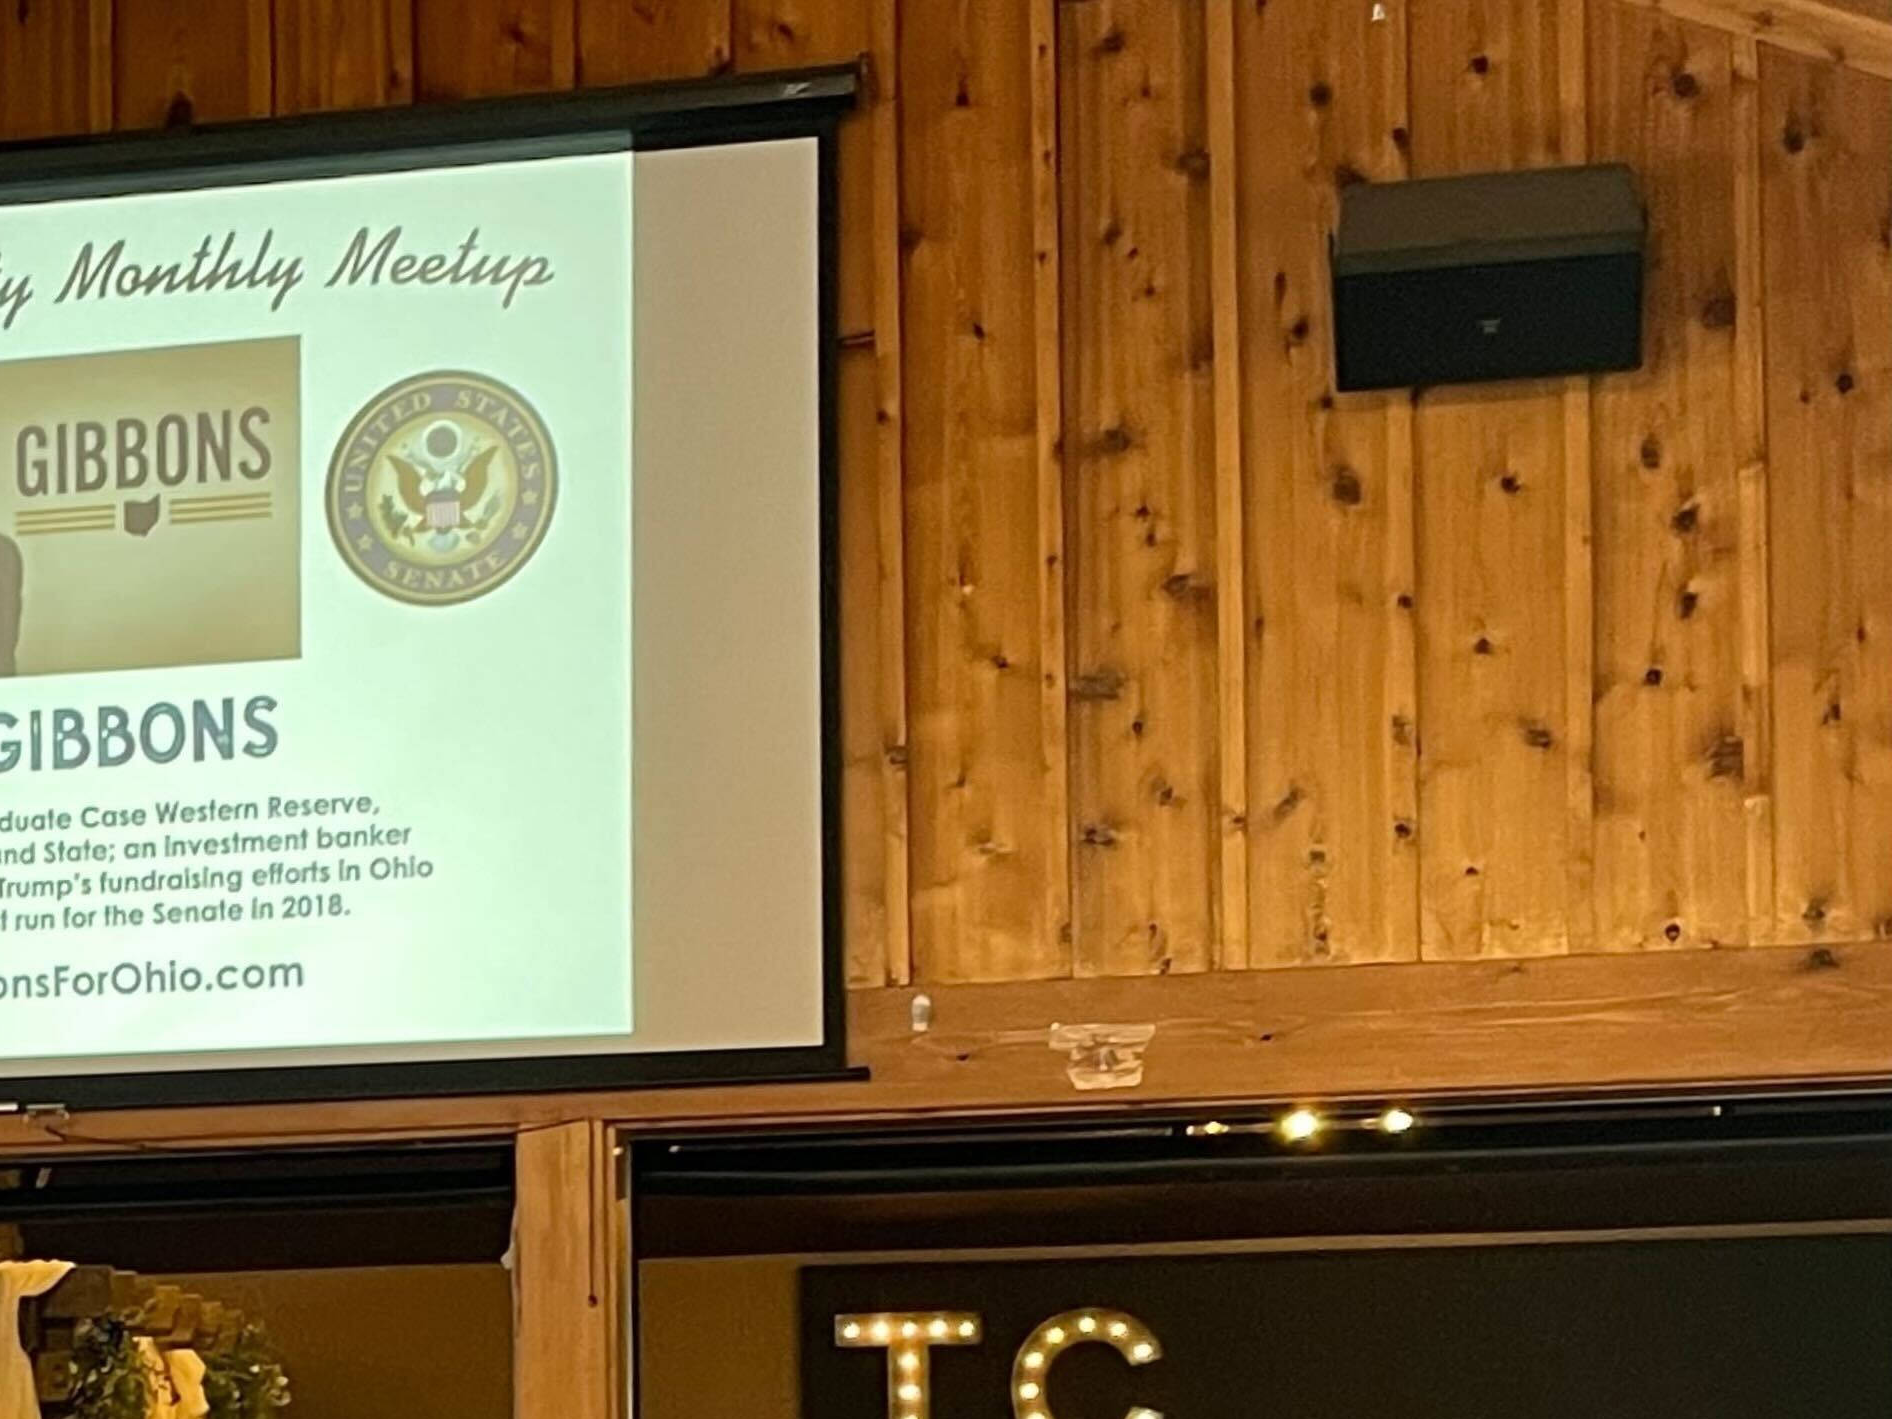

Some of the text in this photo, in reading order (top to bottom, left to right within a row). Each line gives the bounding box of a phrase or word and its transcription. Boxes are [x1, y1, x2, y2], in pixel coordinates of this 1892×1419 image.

[54, 228, 304, 311] Monthly
[324, 226, 555, 310] Meetup
[16, 405, 272, 497] GIBBONS
[345, 390, 541, 492] UNITED STATES
[383, 550, 503, 589] SENATE
[81, 805, 147, 829] Case
[155, 799, 259, 824] Western
[267, 796, 381, 818] Reserve,
[43, 838, 116, 865] State;
[123, 840, 158, 860] an
[316, 824, 412, 851] banker
[99, 866, 243, 895] fundraising
[251, 860, 331, 887] efforts
[369, 854, 434, 881] Ohio
[15, 910, 56, 931] run
[63, 906, 97, 929] for
[104, 904, 145, 928] the
[152, 901, 243, 925] Senate
[282, 894, 351, 920] 2018.
